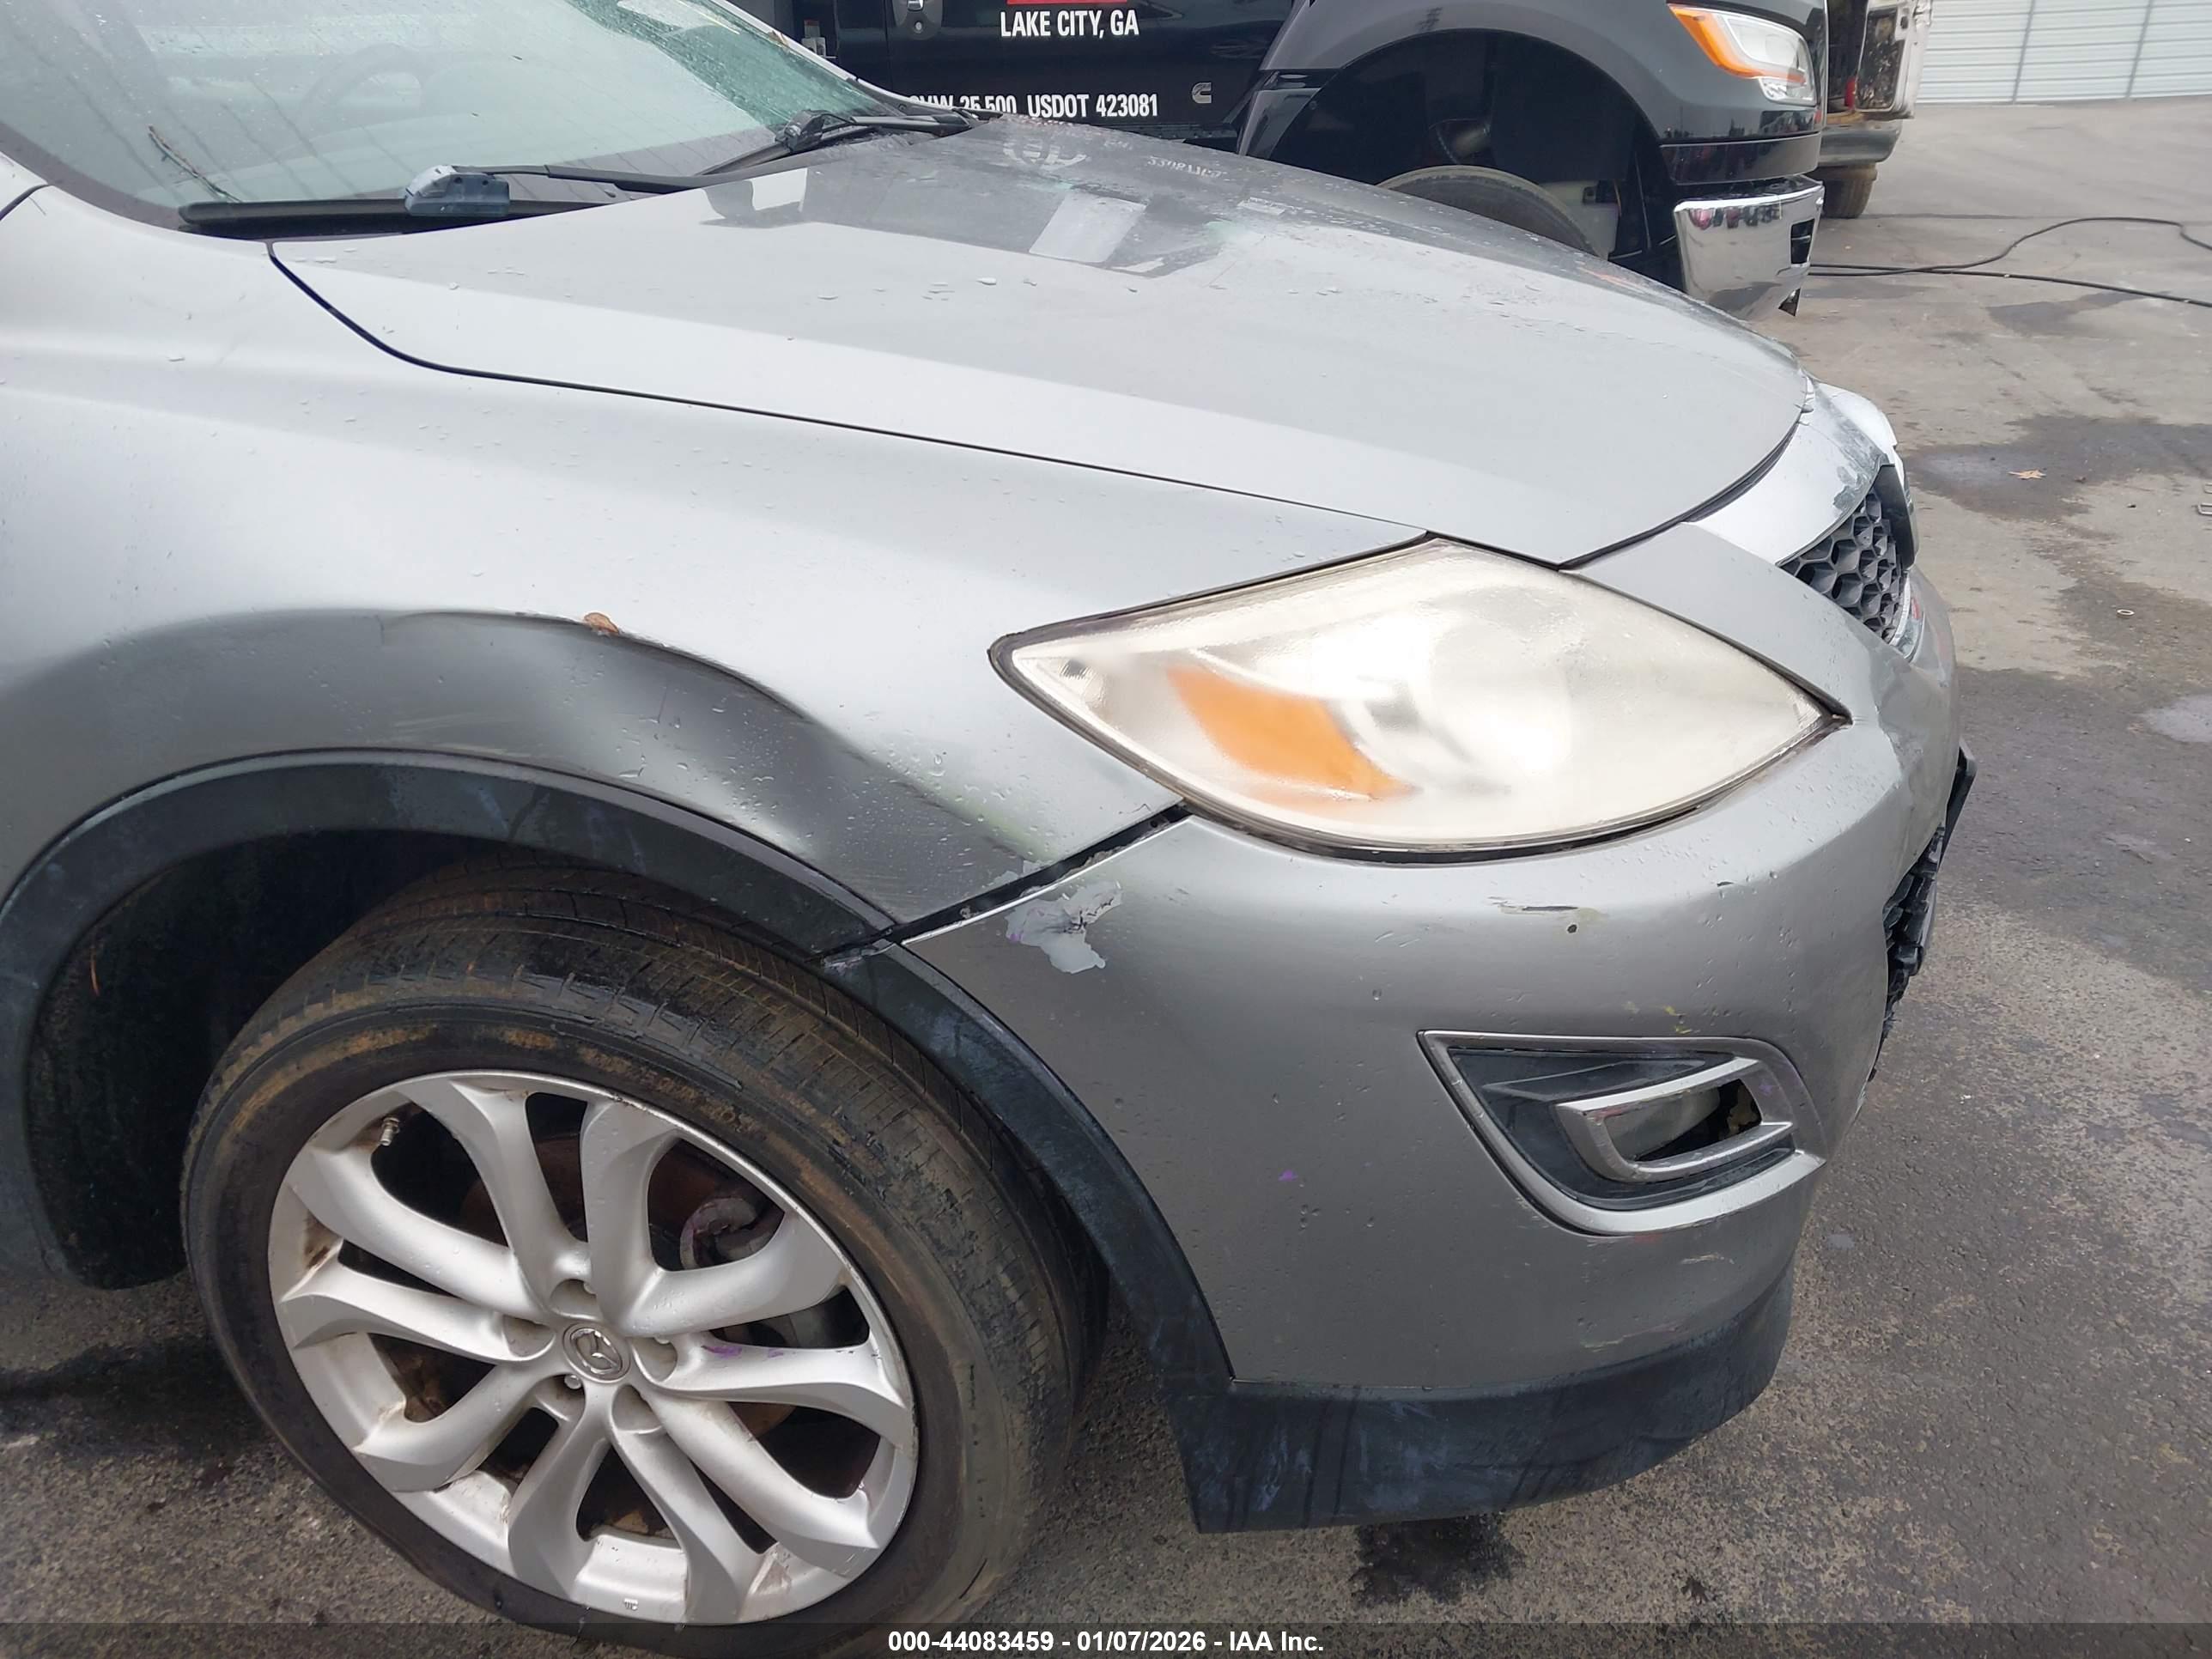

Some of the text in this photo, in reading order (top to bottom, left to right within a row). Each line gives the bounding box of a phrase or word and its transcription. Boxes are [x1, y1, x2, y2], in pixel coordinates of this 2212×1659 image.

[1000, 9, 1139, 39] LAKE CITY, GA
[1027, 94, 1090, 118] USDOT
[1096, 94, 1158, 117] 423081
